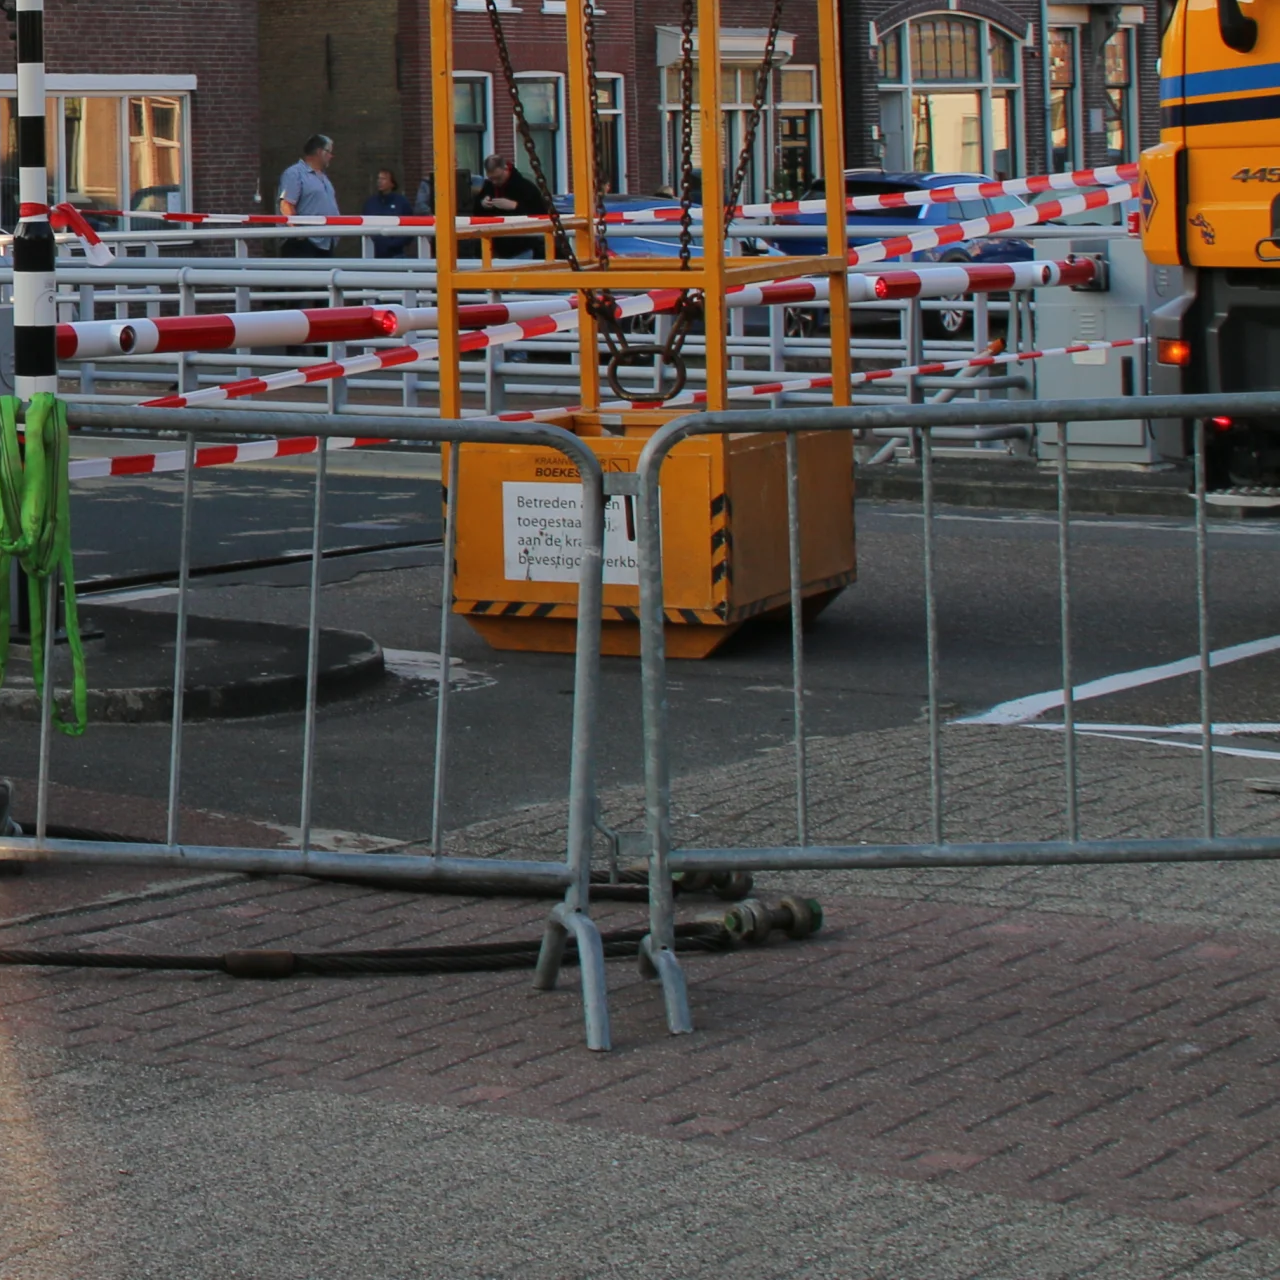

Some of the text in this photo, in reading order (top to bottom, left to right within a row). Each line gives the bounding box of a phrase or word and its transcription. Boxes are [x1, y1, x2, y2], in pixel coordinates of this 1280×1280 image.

[517, 496, 576, 509] Betreden
[517, 517, 582, 530] toegestaa
[518, 537, 541, 546] aan
[545, 533, 562, 547] de
